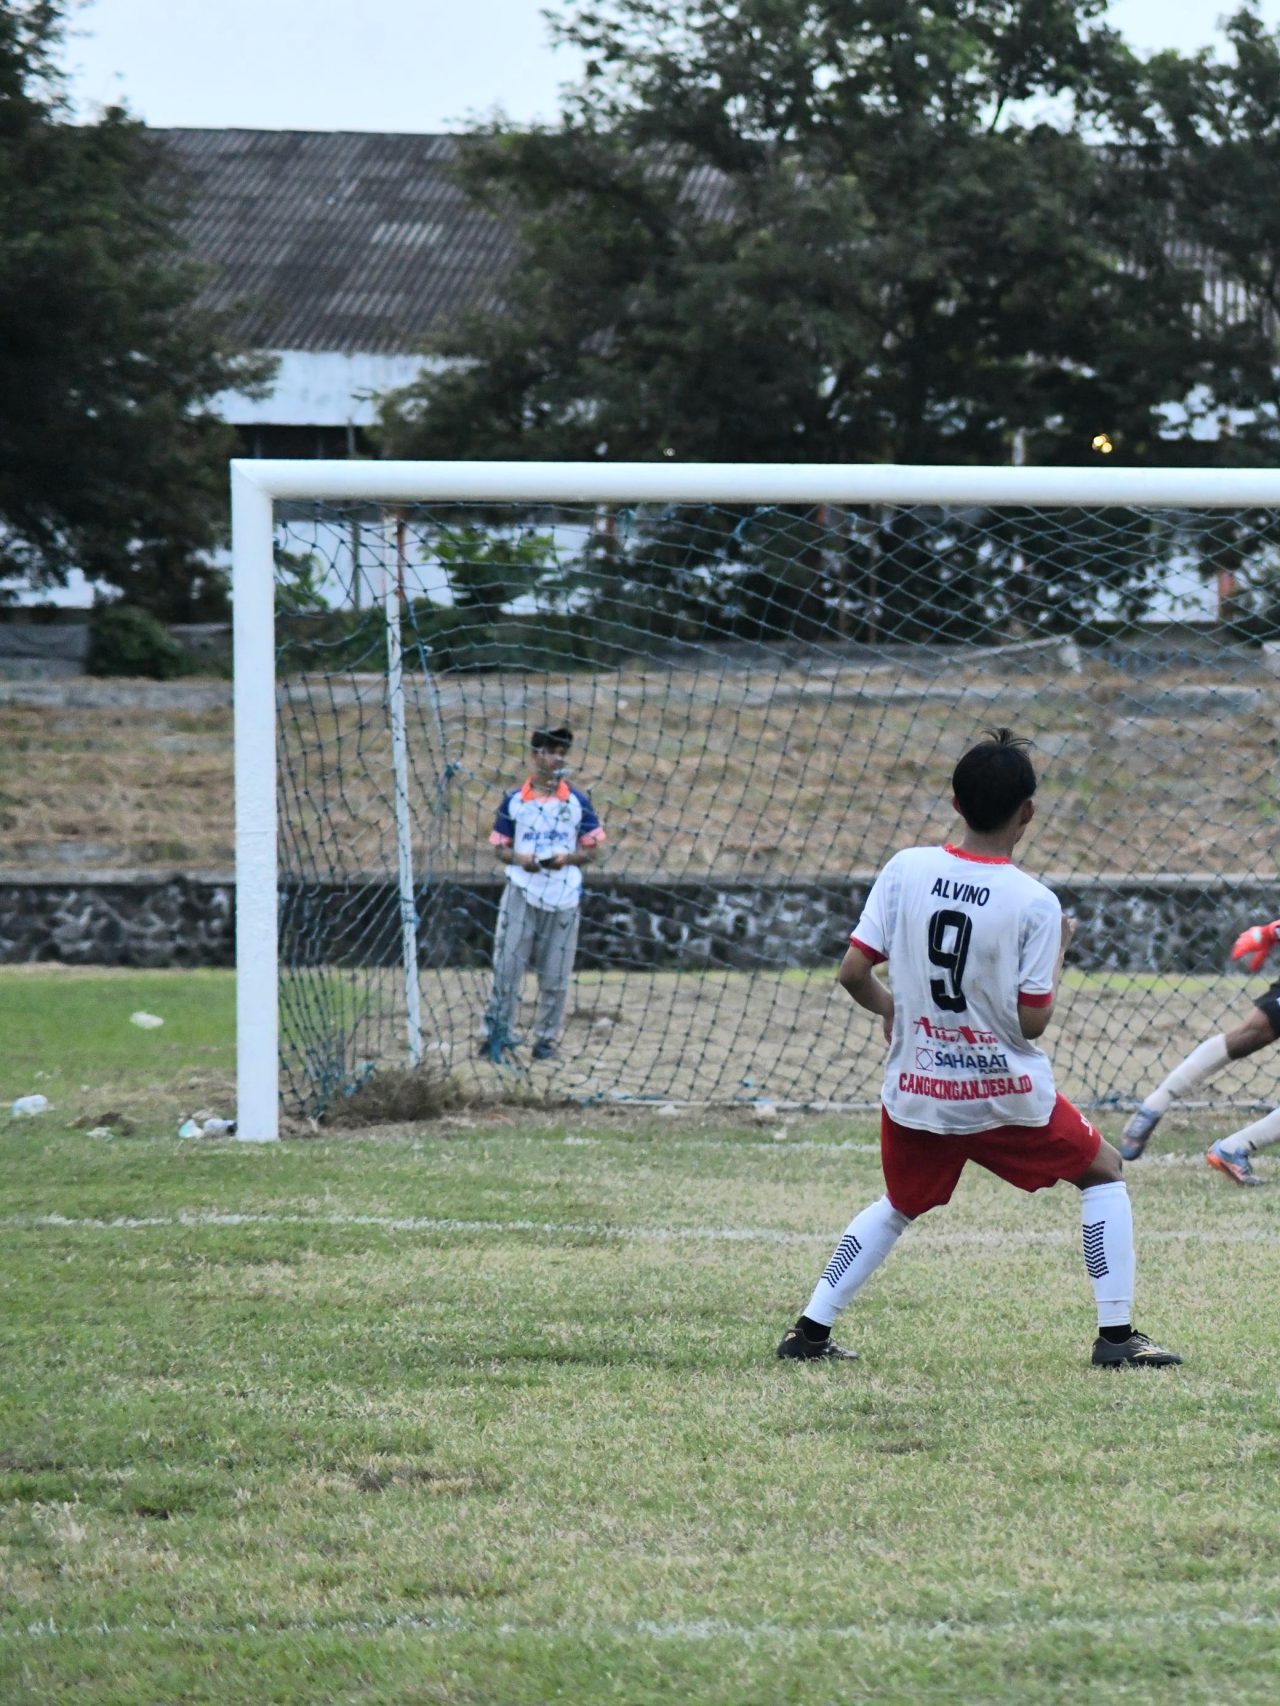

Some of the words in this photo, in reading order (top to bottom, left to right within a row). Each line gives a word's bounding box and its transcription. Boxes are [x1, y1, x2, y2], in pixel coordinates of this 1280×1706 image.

[931, 878, 990, 907] ALVINO
[928, 909, 973, 1014] 9
[934, 1051, 1008, 1069] SAHABAT
[899, 1073, 1033, 1101] CANGKINGAN.DESA.ID
